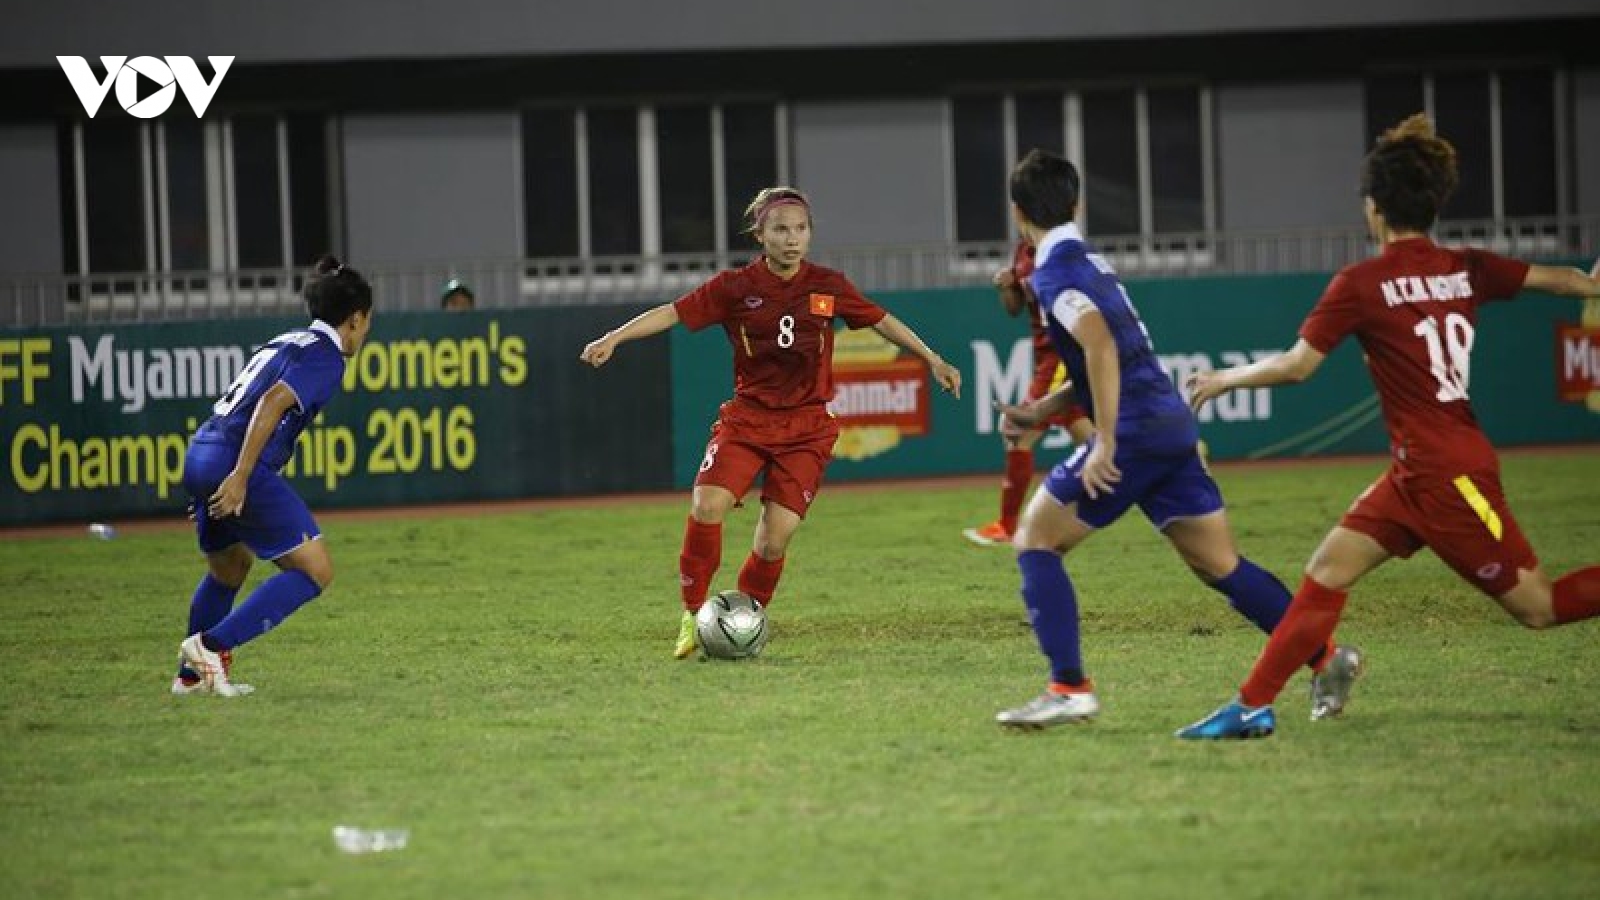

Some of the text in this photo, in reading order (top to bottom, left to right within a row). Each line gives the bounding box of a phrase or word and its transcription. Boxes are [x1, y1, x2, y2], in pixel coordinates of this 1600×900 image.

[777, 315, 794, 348] 8
[68, 334, 262, 413] Myanm
[826, 380, 922, 418] anmar
[367, 406, 476, 474] 2016
